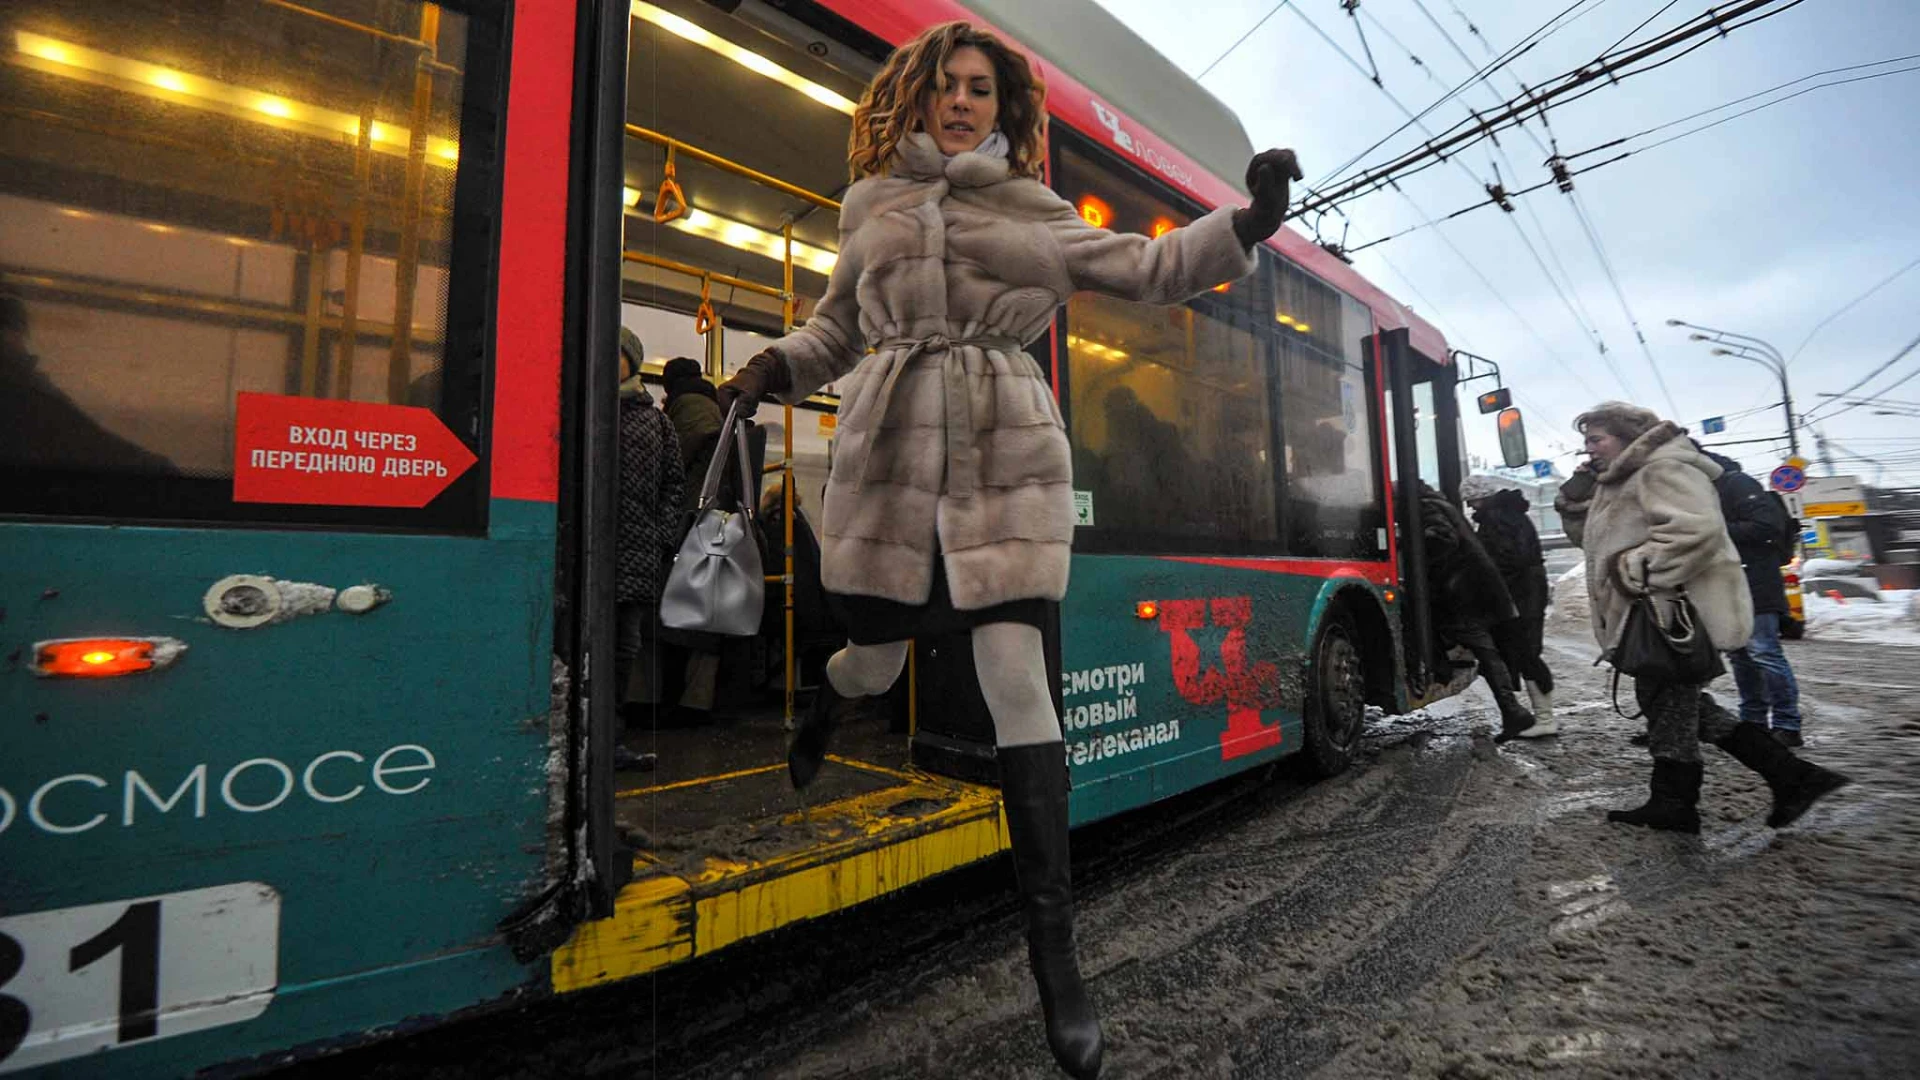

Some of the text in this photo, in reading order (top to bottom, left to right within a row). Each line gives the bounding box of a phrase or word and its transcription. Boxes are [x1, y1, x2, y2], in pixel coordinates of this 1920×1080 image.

[289, 425, 417, 452] ВХОД ЧЕРЕЗ
[251, 449, 448, 478] ПЕРЕДНЮЮ ДВЕРЬ
[1062, 662, 1145, 697] смотри
[0, 744, 436, 834] смосе
